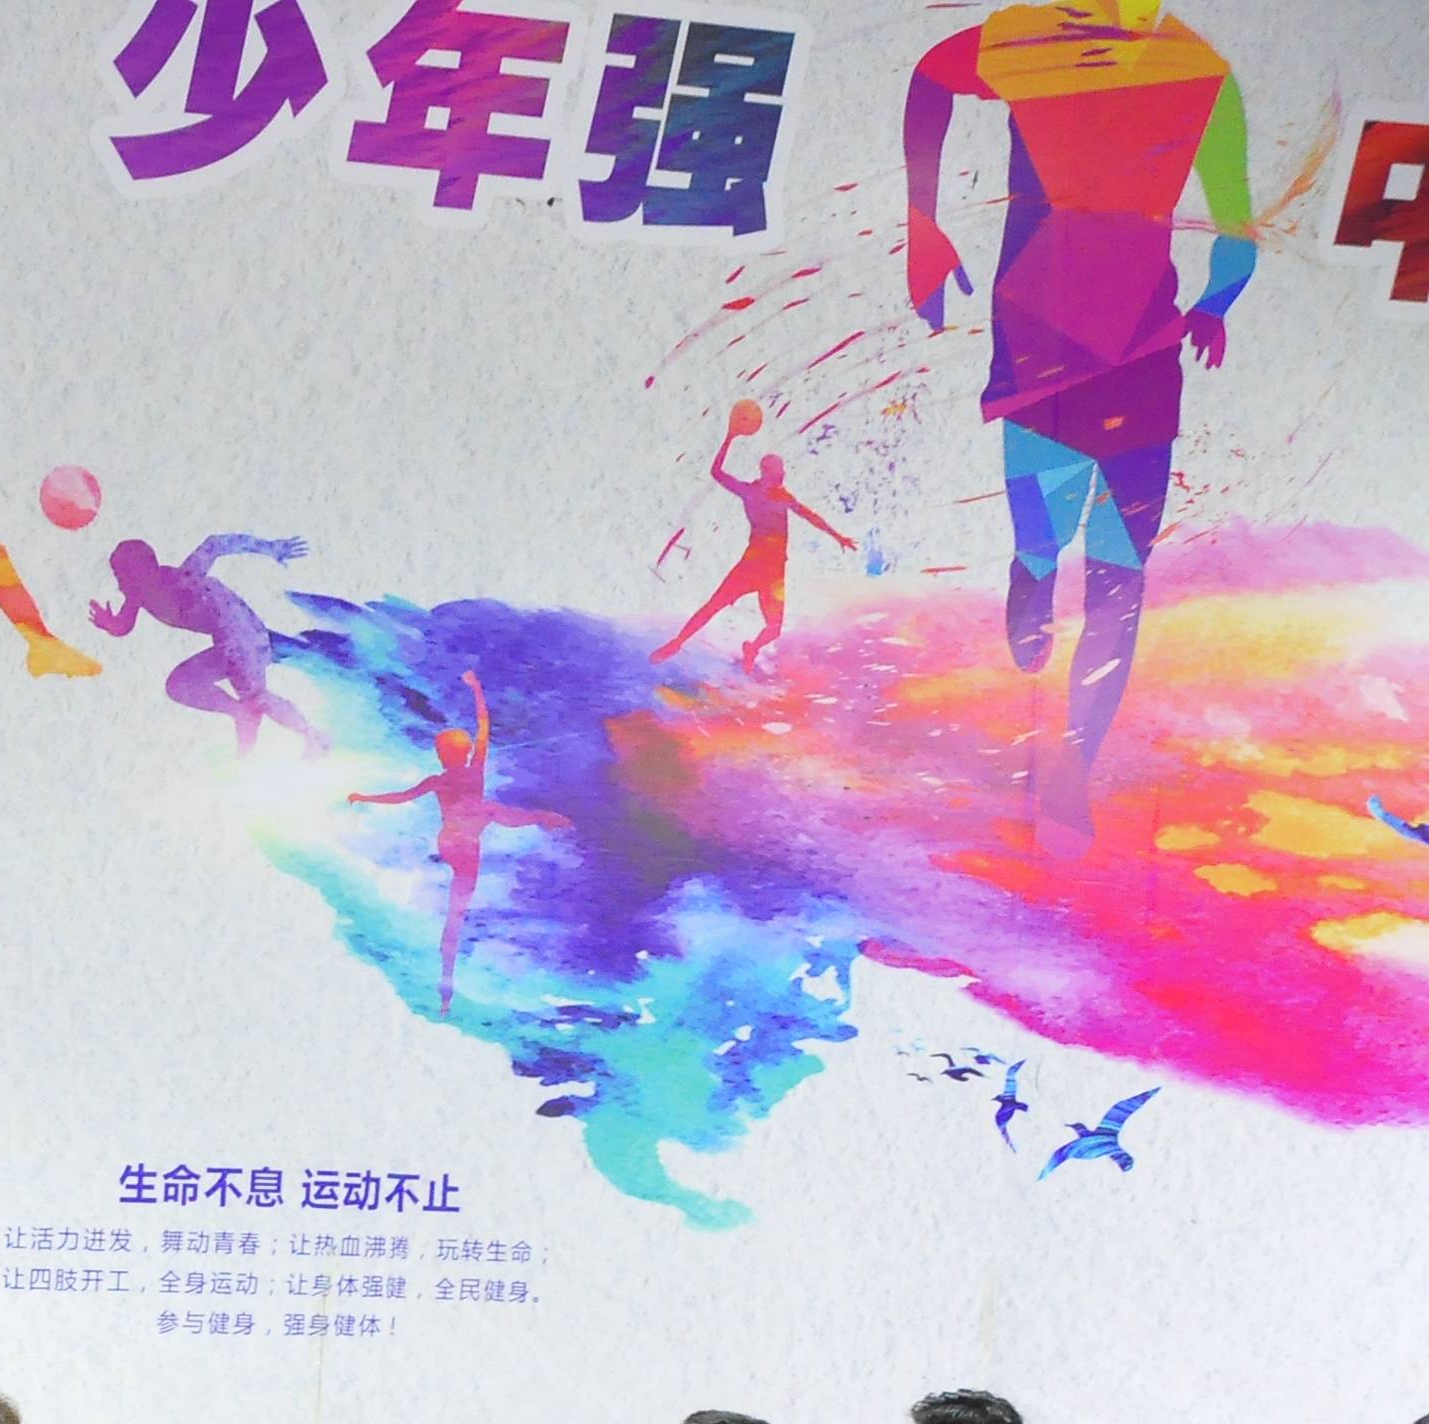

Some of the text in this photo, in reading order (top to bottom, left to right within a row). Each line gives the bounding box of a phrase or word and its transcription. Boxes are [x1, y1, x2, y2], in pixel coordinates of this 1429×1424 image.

[109, 0, 796, 236] 少年强
[119, 1162, 461, 1213] 生命不息 运动不止
